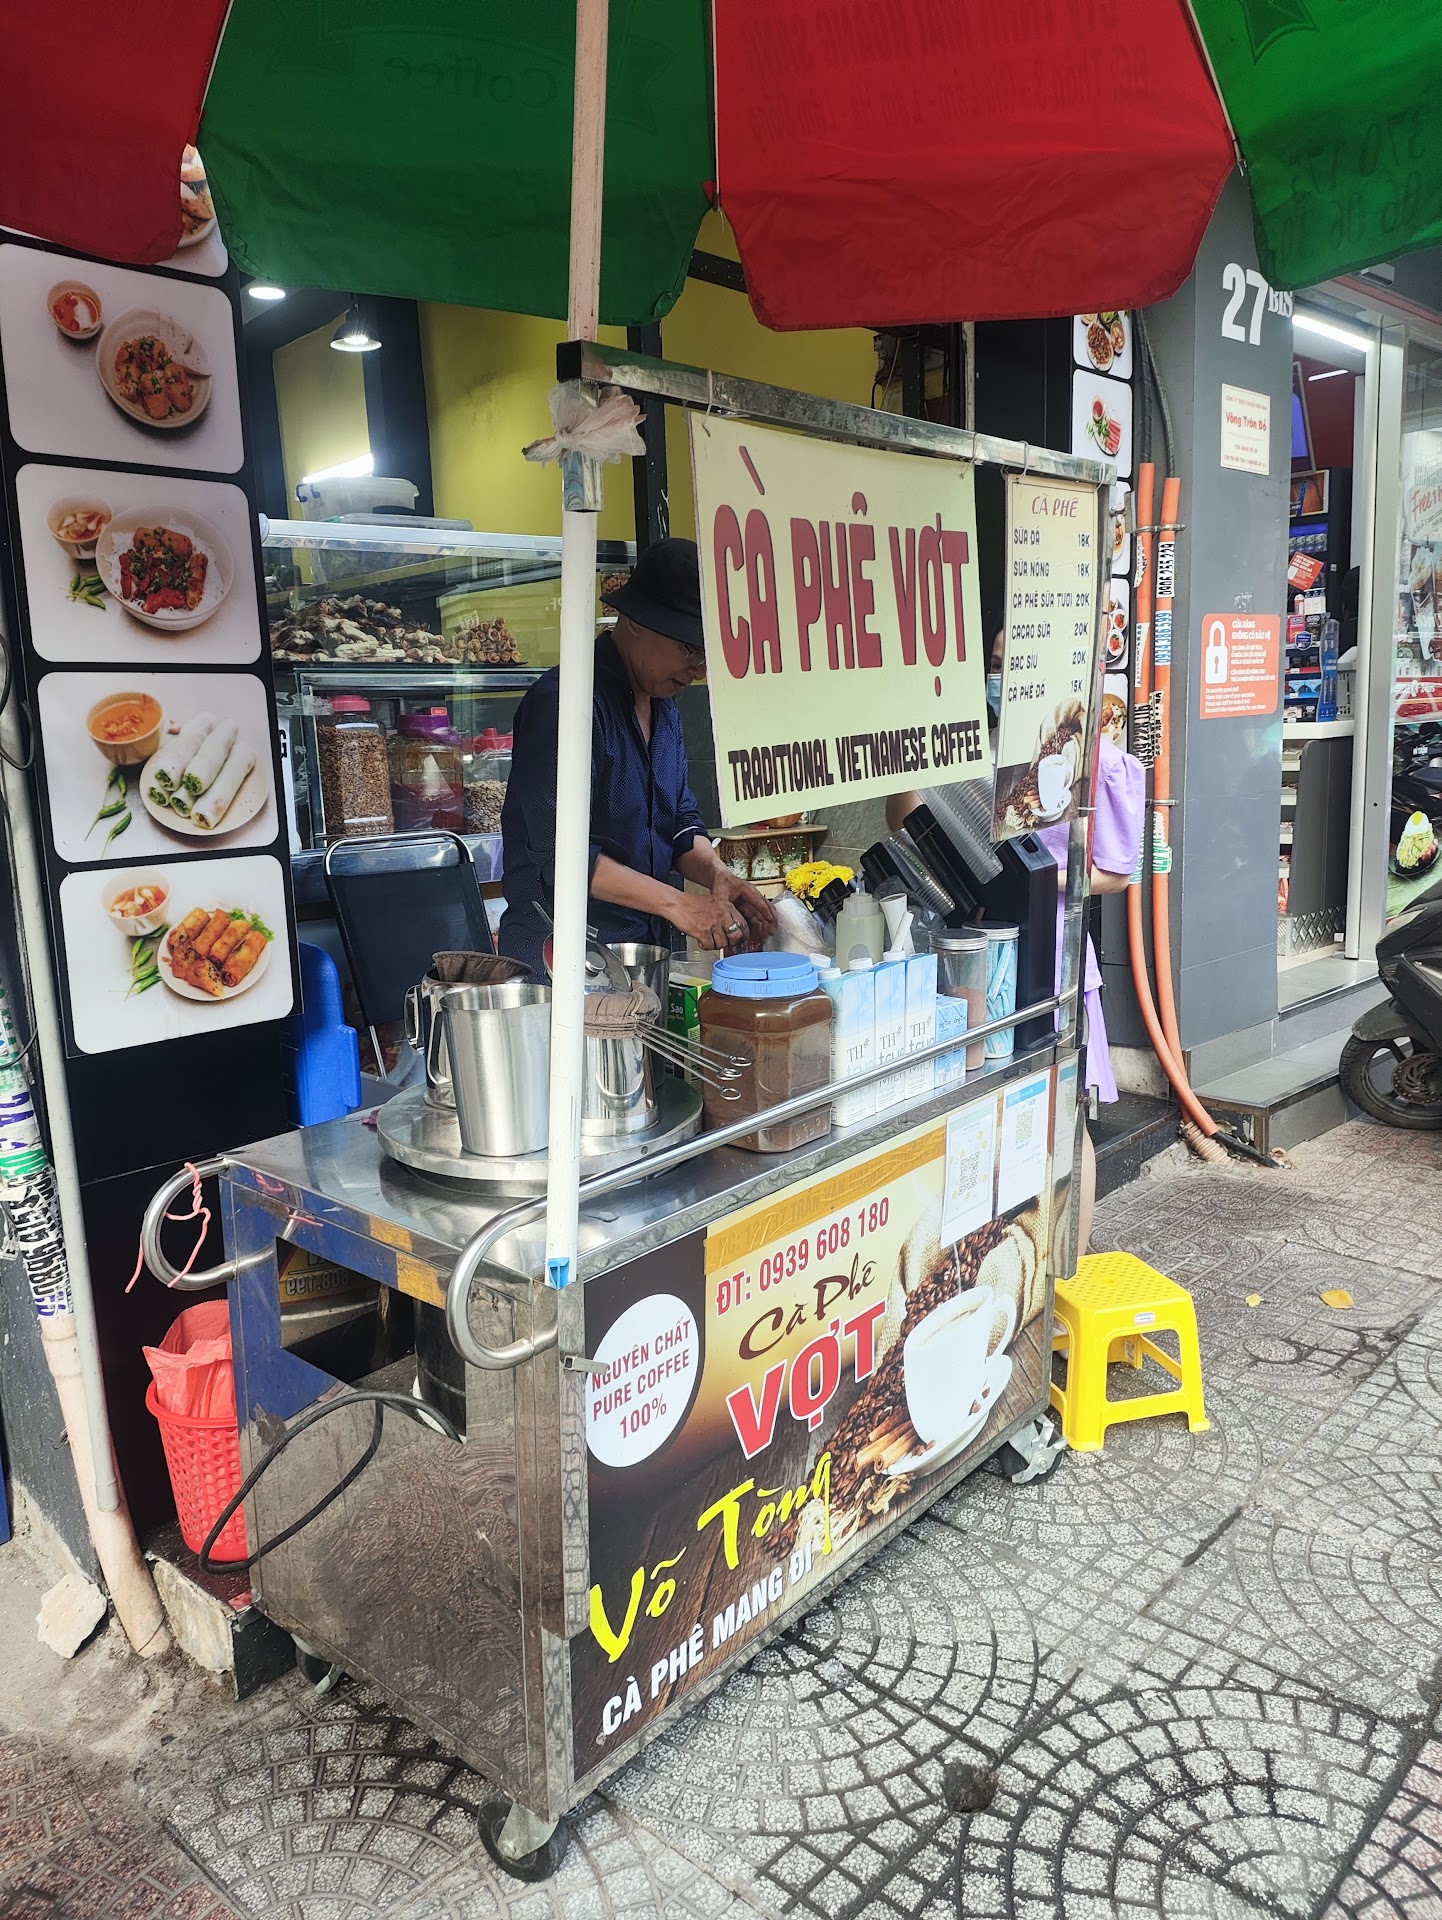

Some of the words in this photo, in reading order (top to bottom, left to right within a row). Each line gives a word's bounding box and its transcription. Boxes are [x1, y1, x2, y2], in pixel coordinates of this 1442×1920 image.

[1221, 263, 1268, 346] 27
[1226, 411, 1242, 428] Vòng
[1031, 492, 1048, 516] CÀ
[1052, 496, 1079, 518] PHÊ
[1411, 488, 1432, 523] Free
[1013, 525, 1028, 545] SỮA
[1030, 524, 1041, 546] ĐÁ
[1077, 533, 1091, 548] 18K
[713, 445, 783, 680] CÀ
[789, 491, 883, 672] PHÊ
[888, 512, 970, 698] VỢT
[1013, 557, 1028, 577] SỮA
[1030, 556, 1050, 577] NÓNG
[1077, 562, 1090, 577] 18K
[1013, 587, 1023, 609] CÀ
[1025, 590, 1038, 608] PHÊ
[1075, 592, 1090, 607] 20K
[1012, 624, 1034, 641] CACAO
[1074, 622, 1088, 637] 20K
[1010, 655, 1024, 674] BẠC
[1072, 650, 1086, 665] 20K
[1008, 682, 1018, 703] CÀ
[1020, 682, 1034, 700] PHÊ
[1035, 678, 1046, 698] ĐÁ
[1070, 679, 1083, 693] 15K
[728, 737, 834, 803] TRADITIONAL
[836, 725, 929, 783] VIETNAMESE
[931, 719, 983, 767] COFFEE
[670, 1003, 684, 1014] Sao
[879, 1032, 896, 1050] TH
[910, 1021, 926, 1038] TH
[847, 1044, 864, 1063] TH
[715, 1271, 751, 1317] ĐT:
[759, 1241, 809, 1292] 0939
[816, 1217, 850, 1259] 608
[858, 1196, 890, 1238] 180
[738, 1303, 806, 1361] Cà
[813, 1252, 877, 1322] Phê
[591, 1343, 650, 1394] NGUYÊN
[654, 1316, 691, 1357] CHẤT
[592, 1379, 632, 1422] PURE
[637, 1350, 690, 1393] COFFEE
[726, 1300, 886, 1460] VỢT
[619, 1397, 668, 1439] 100%
[588, 1546, 687, 1664] Võ
[697, 1451, 833, 1571] Tòng
[602, 1675, 642, 1736] CÀ
[650, 1623, 704, 1699] PHÊ
[712, 1565, 783, 1650] MANG
[789, 1543, 814, 1586] ĐI
